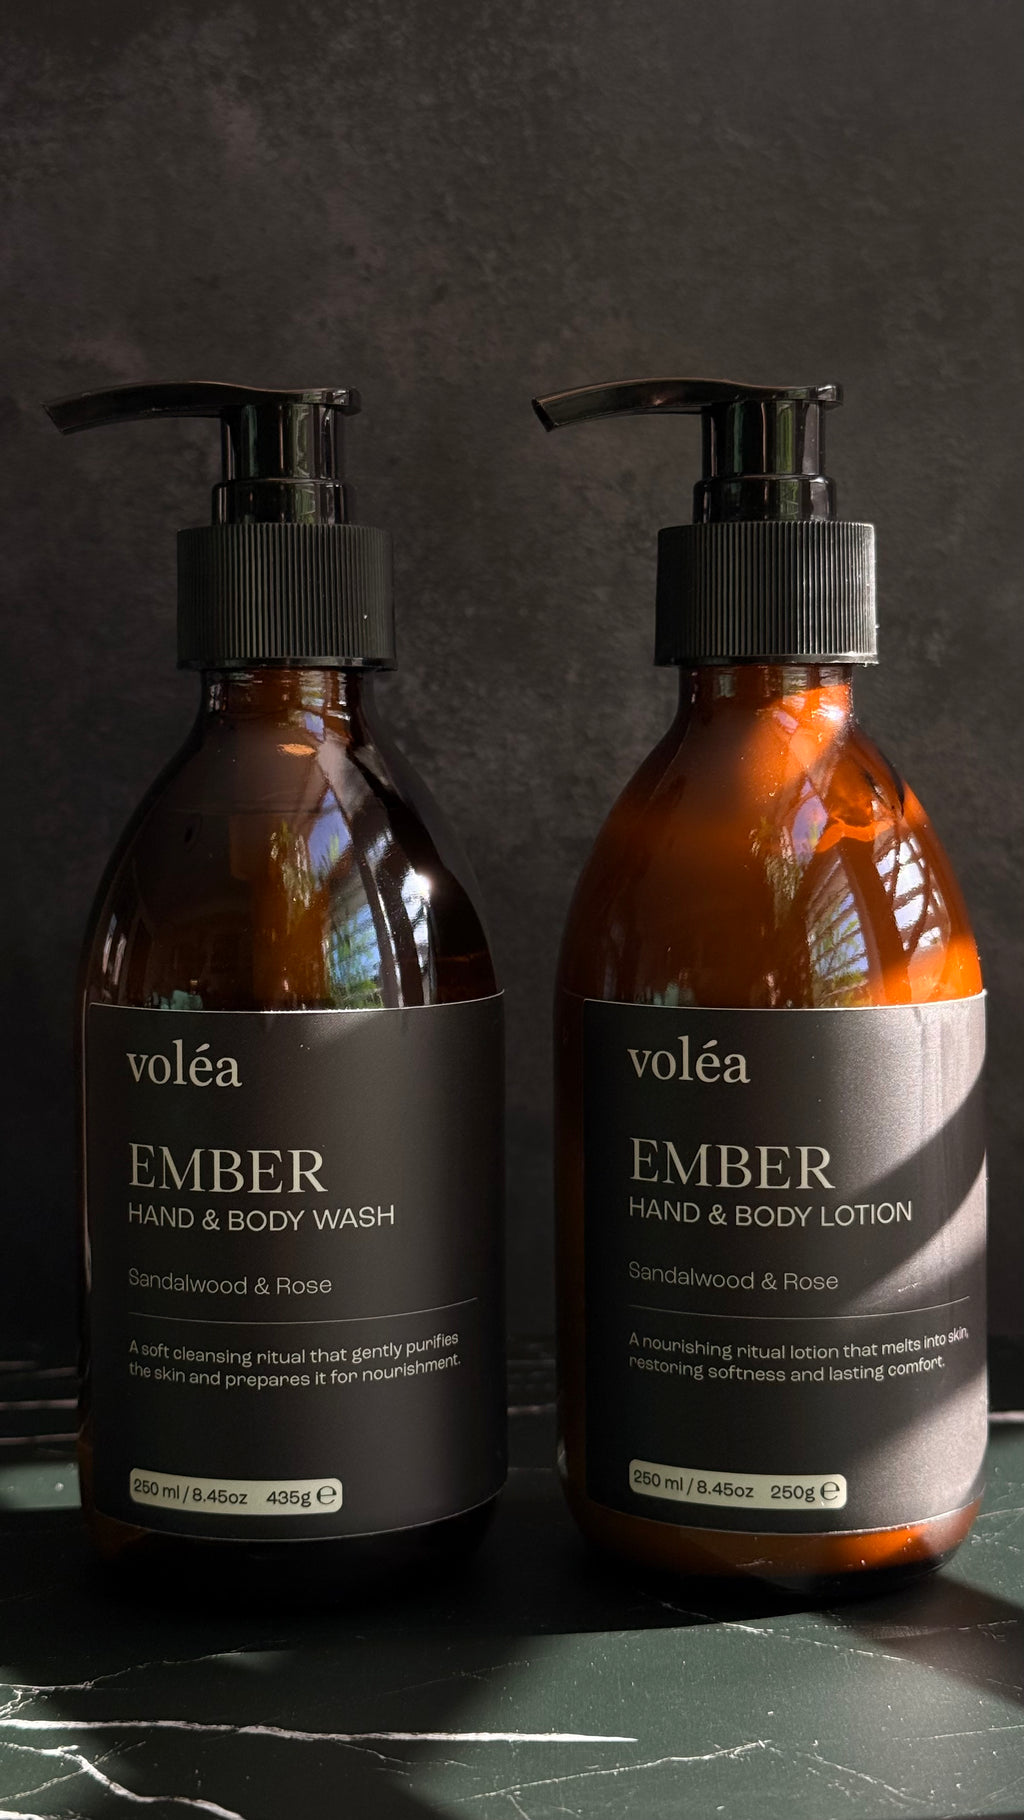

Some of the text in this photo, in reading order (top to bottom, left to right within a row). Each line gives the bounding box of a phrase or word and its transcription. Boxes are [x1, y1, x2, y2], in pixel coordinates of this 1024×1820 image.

[127, 1039, 242, 1087] voléa
[628, 1036, 750, 1083] voléa
[129, 1143, 328, 1193] EMBER
[630, 1137, 836, 1190] EMBER
[129, 1202, 394, 1231] HAND & BODY WASH
[629, 1197, 911, 1226] HAND & BODY LOTION
[129, 1267, 331, 1295] Sandalwood & Rose
[630, 1262, 838, 1290] Sandalwood & Rose
[129, 1333, 459, 1367] A soft cleansing ritual that gently purifies
[629, 1326, 969, 1361] A nourishing ritual lotion that melts into skin,
[130, 1353, 461, 1390] the skin and prepares it for nourishment.
[629, 1354, 945, 1381] restoring softness and lasting comfort.
[133, 1479, 159, 1496] 250
[163, 1484, 180, 1500] ml
[193, 1488, 247, 1504] 8.45oz
[266, 1490, 312, 1508] 435g
[633, 1470, 660, 1488] 250
[665, 1475, 683, 1491] ml
[697, 1480, 753, 1497] 8.45oz
[770, 1484, 816, 1503] 250g
